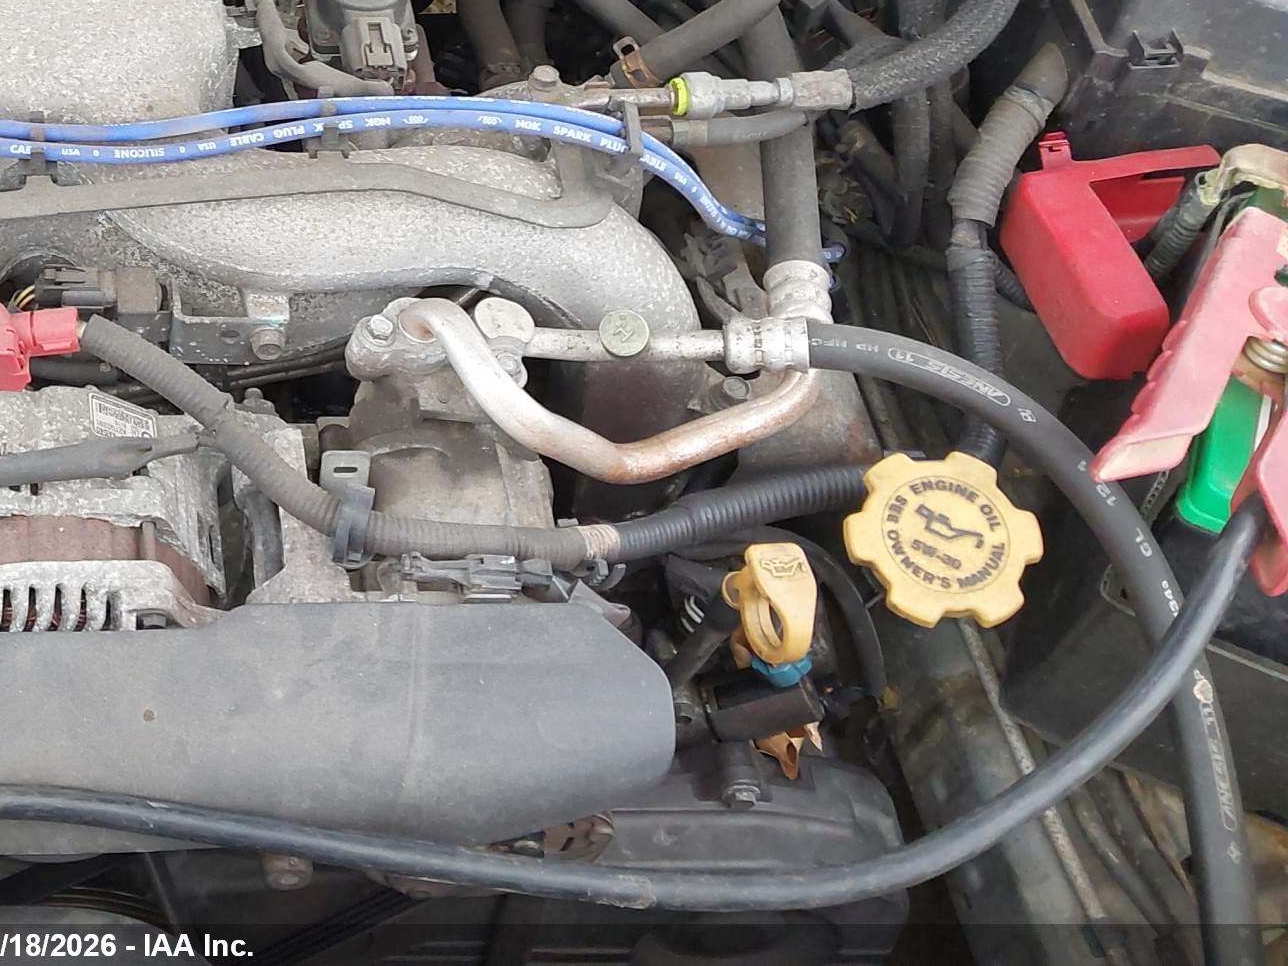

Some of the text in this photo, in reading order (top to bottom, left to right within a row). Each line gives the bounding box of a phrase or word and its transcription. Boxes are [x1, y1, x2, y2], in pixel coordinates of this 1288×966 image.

[273, 126, 304, 138] PLUG
[515, 119, 541, 131] NGK
[553, 125, 591, 142] SPARK
[196, 141, 216, 151] USA
[230, 133, 264, 147] CABLE
[114, 147, 165, 158] SILICONE
[910, 480, 1002, 532] ENGINE OIL
[887, 529, 952, 589] OWNER'S
[956, 542, 1006, 588] MANUAL
[910, 539, 962, 570] 5W-30
